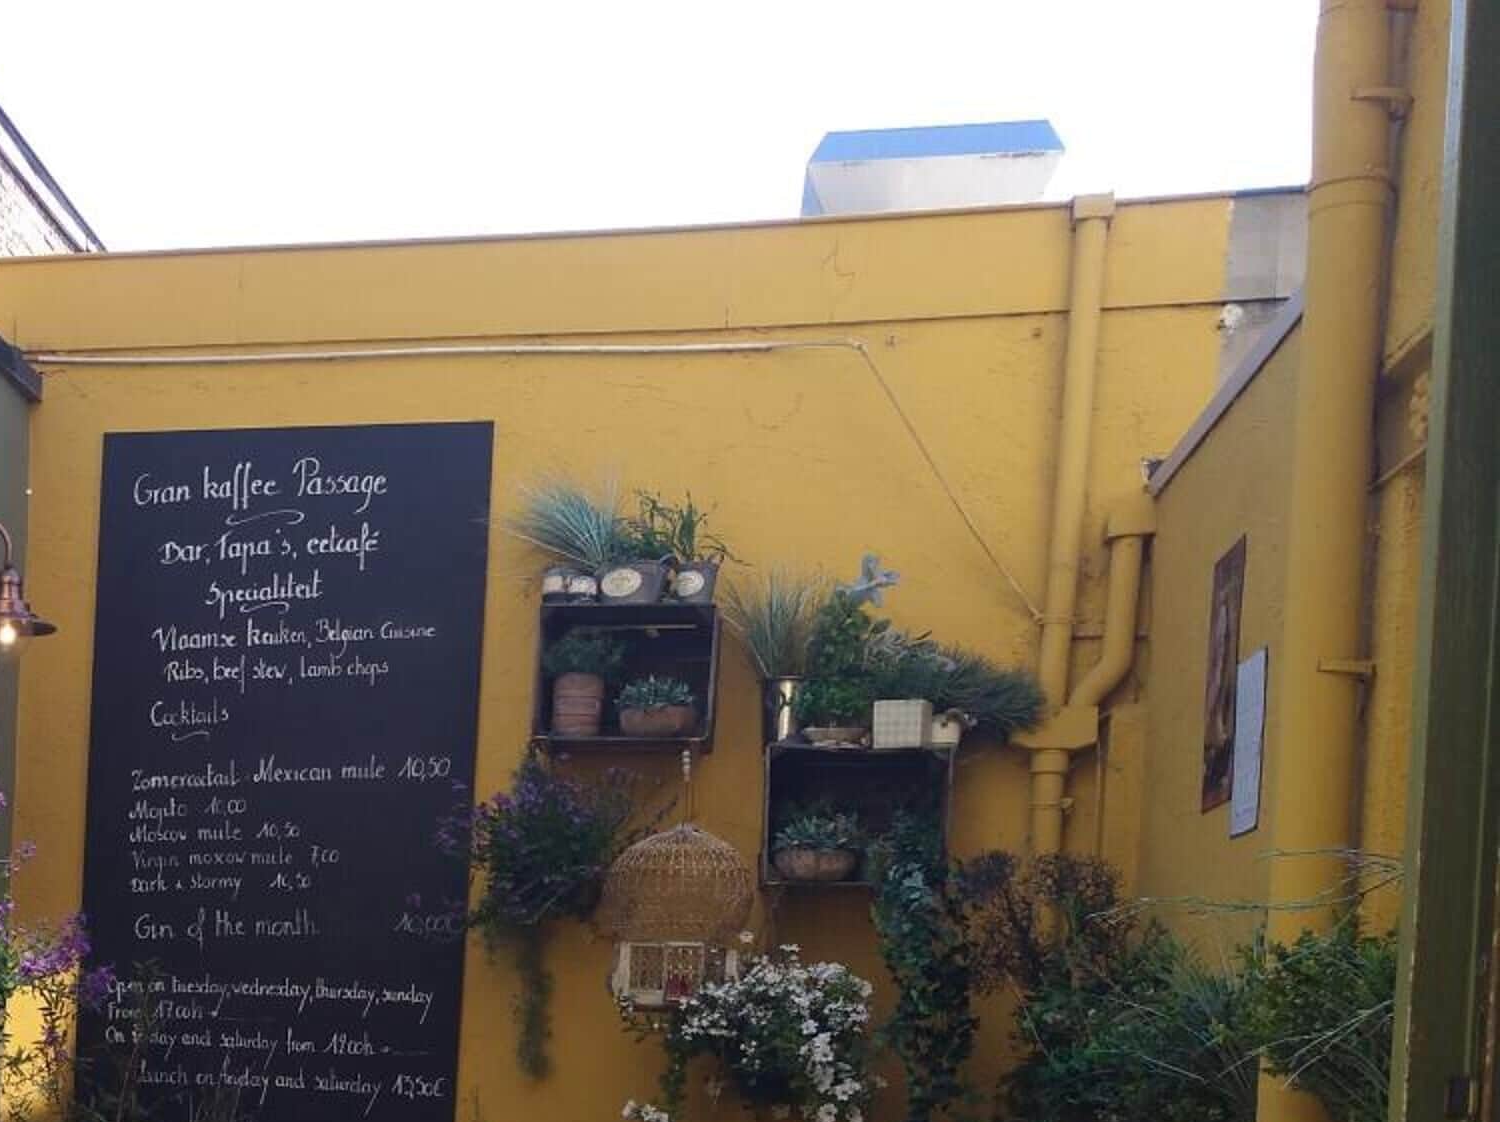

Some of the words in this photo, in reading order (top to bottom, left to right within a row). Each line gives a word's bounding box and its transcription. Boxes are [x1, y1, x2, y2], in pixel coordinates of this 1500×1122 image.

[133, 472, 191, 506] Gran
[292, 456, 388, 514] Passage
[151, 623, 238, 652] Vlaamse
[315, 617, 375, 660] Belgian
[213, 654, 246, 694] beef
[347, 655, 390, 687] chops
[149, 697, 230, 728] Cocktails
[253, 754, 332, 783] Mexican
[341, 754, 387, 780] mule
[397, 756, 452, 782] 10,50
[128, 797, 189, 832] Mojito
[129, 823, 188, 843] Moscow
[197, 820, 244, 841] mule
[250, 845, 293, 866] mule
[134, 912, 174, 940] Gin
[215, 910, 246, 938] the
[382, 984, 434, 1024] sunday
[105, 1026, 126, 1044] On
[275, 1066, 306, 1089] and
